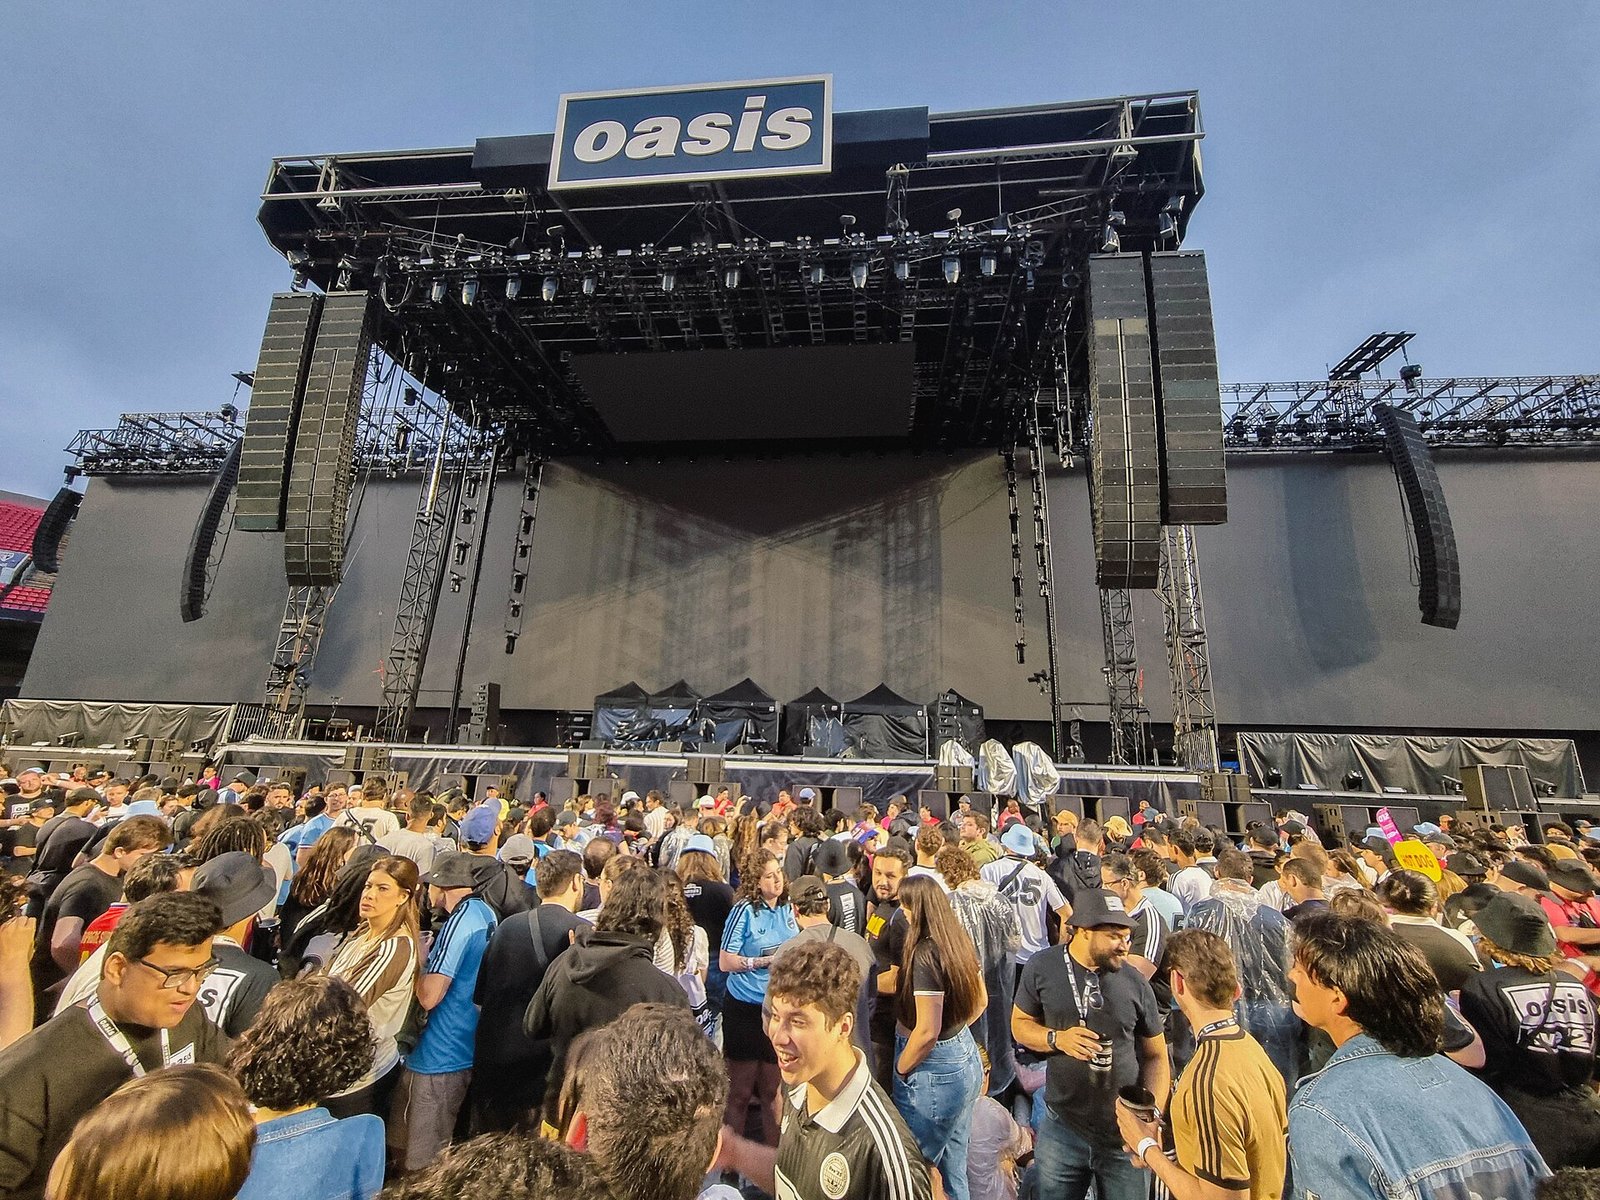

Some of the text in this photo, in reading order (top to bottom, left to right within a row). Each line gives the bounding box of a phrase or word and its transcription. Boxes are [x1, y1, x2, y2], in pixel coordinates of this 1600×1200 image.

[573, 95, 813, 163] oasis
[1413, 854, 1435, 868] DOG
[1526, 993, 1588, 1016] osis
